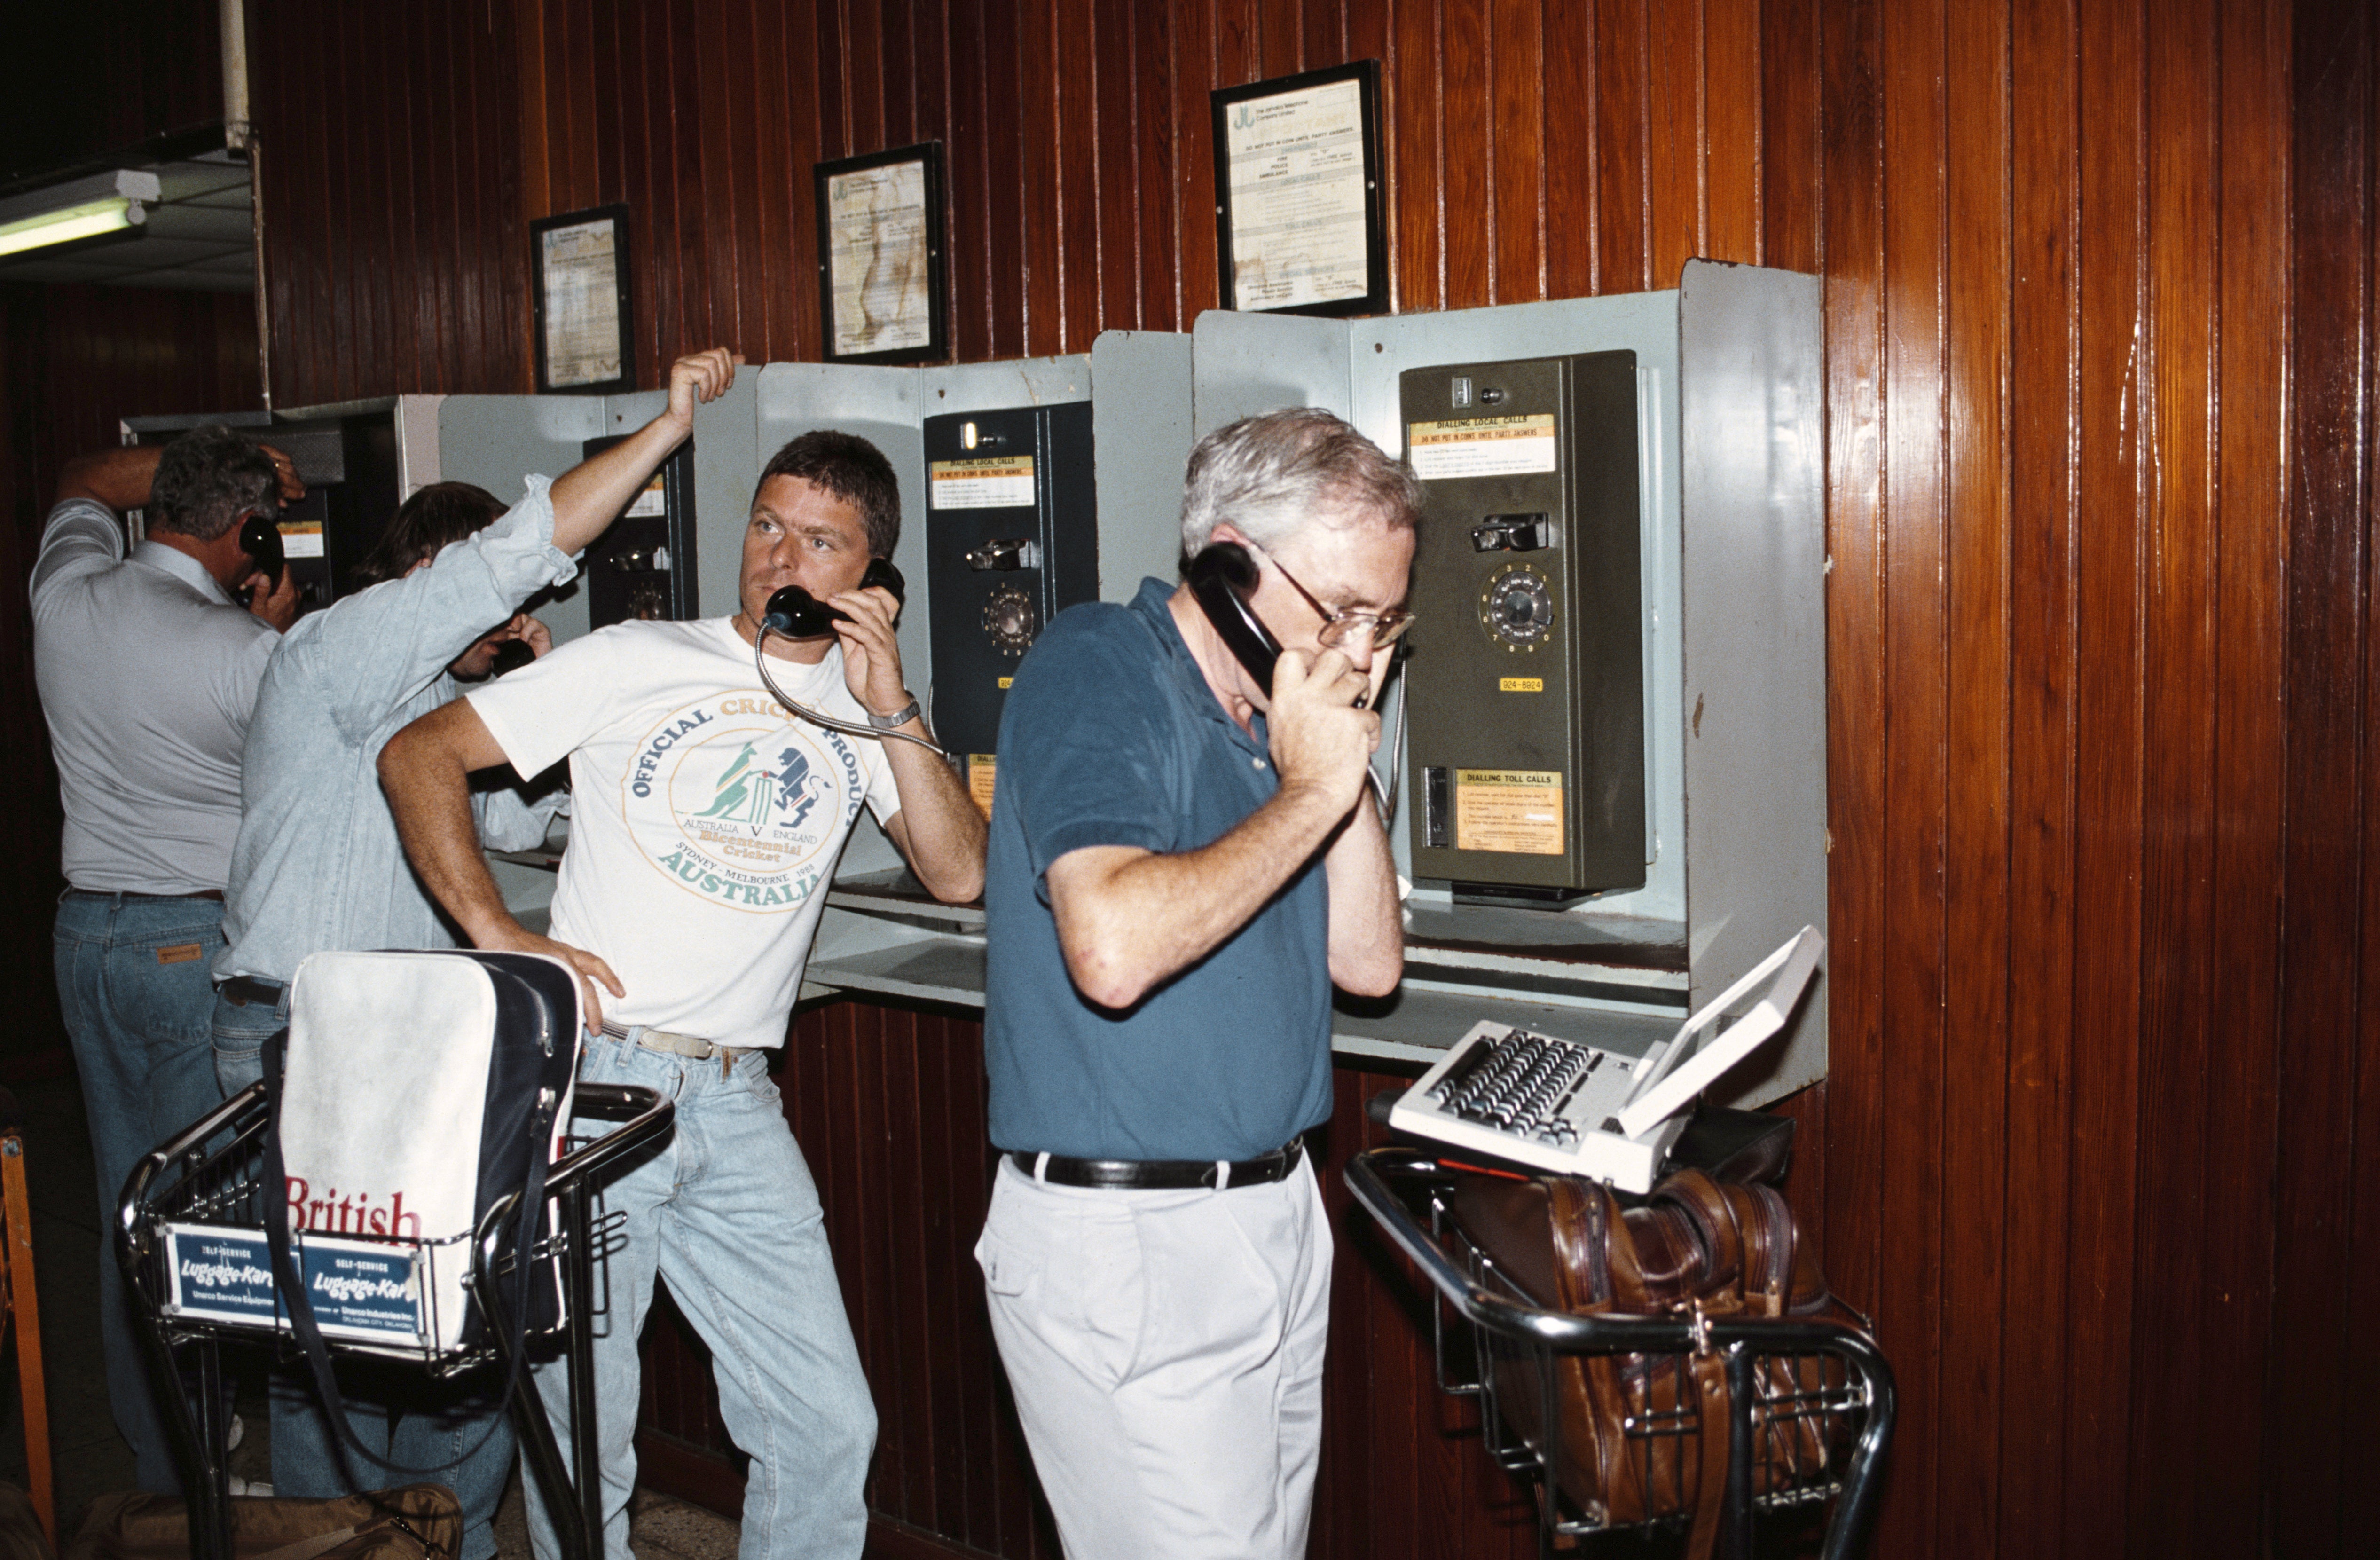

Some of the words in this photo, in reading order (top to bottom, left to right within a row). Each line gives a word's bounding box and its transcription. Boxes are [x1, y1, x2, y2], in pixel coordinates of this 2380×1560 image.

[1437, 420, 1470, 428] DIALLING
[1504, 415, 1527, 424] CALLS
[632, 709, 713, 798] OFFICIAL
[684, 819, 739, 834] AUSTRALIA
[751, 825, 762, 837] V
[773, 830, 817, 844] ENGLAND
[699, 829, 802, 856] Bicentennial
[676, 841, 718, 869] SYDNEY
[725, 870, 790, 884] MELBOURNE
[723, 845, 781, 863] Cricket
[285, 1175, 422, 1248] British
[335, 1258, 388, 1273] SELF-SERVICE
[193, 1290, 216, 1300] Unarco
[217, 1292, 243, 1303] Service
[341, 1306, 366, 1316] Unarco
[366, 1308, 401, 1320] Industries
